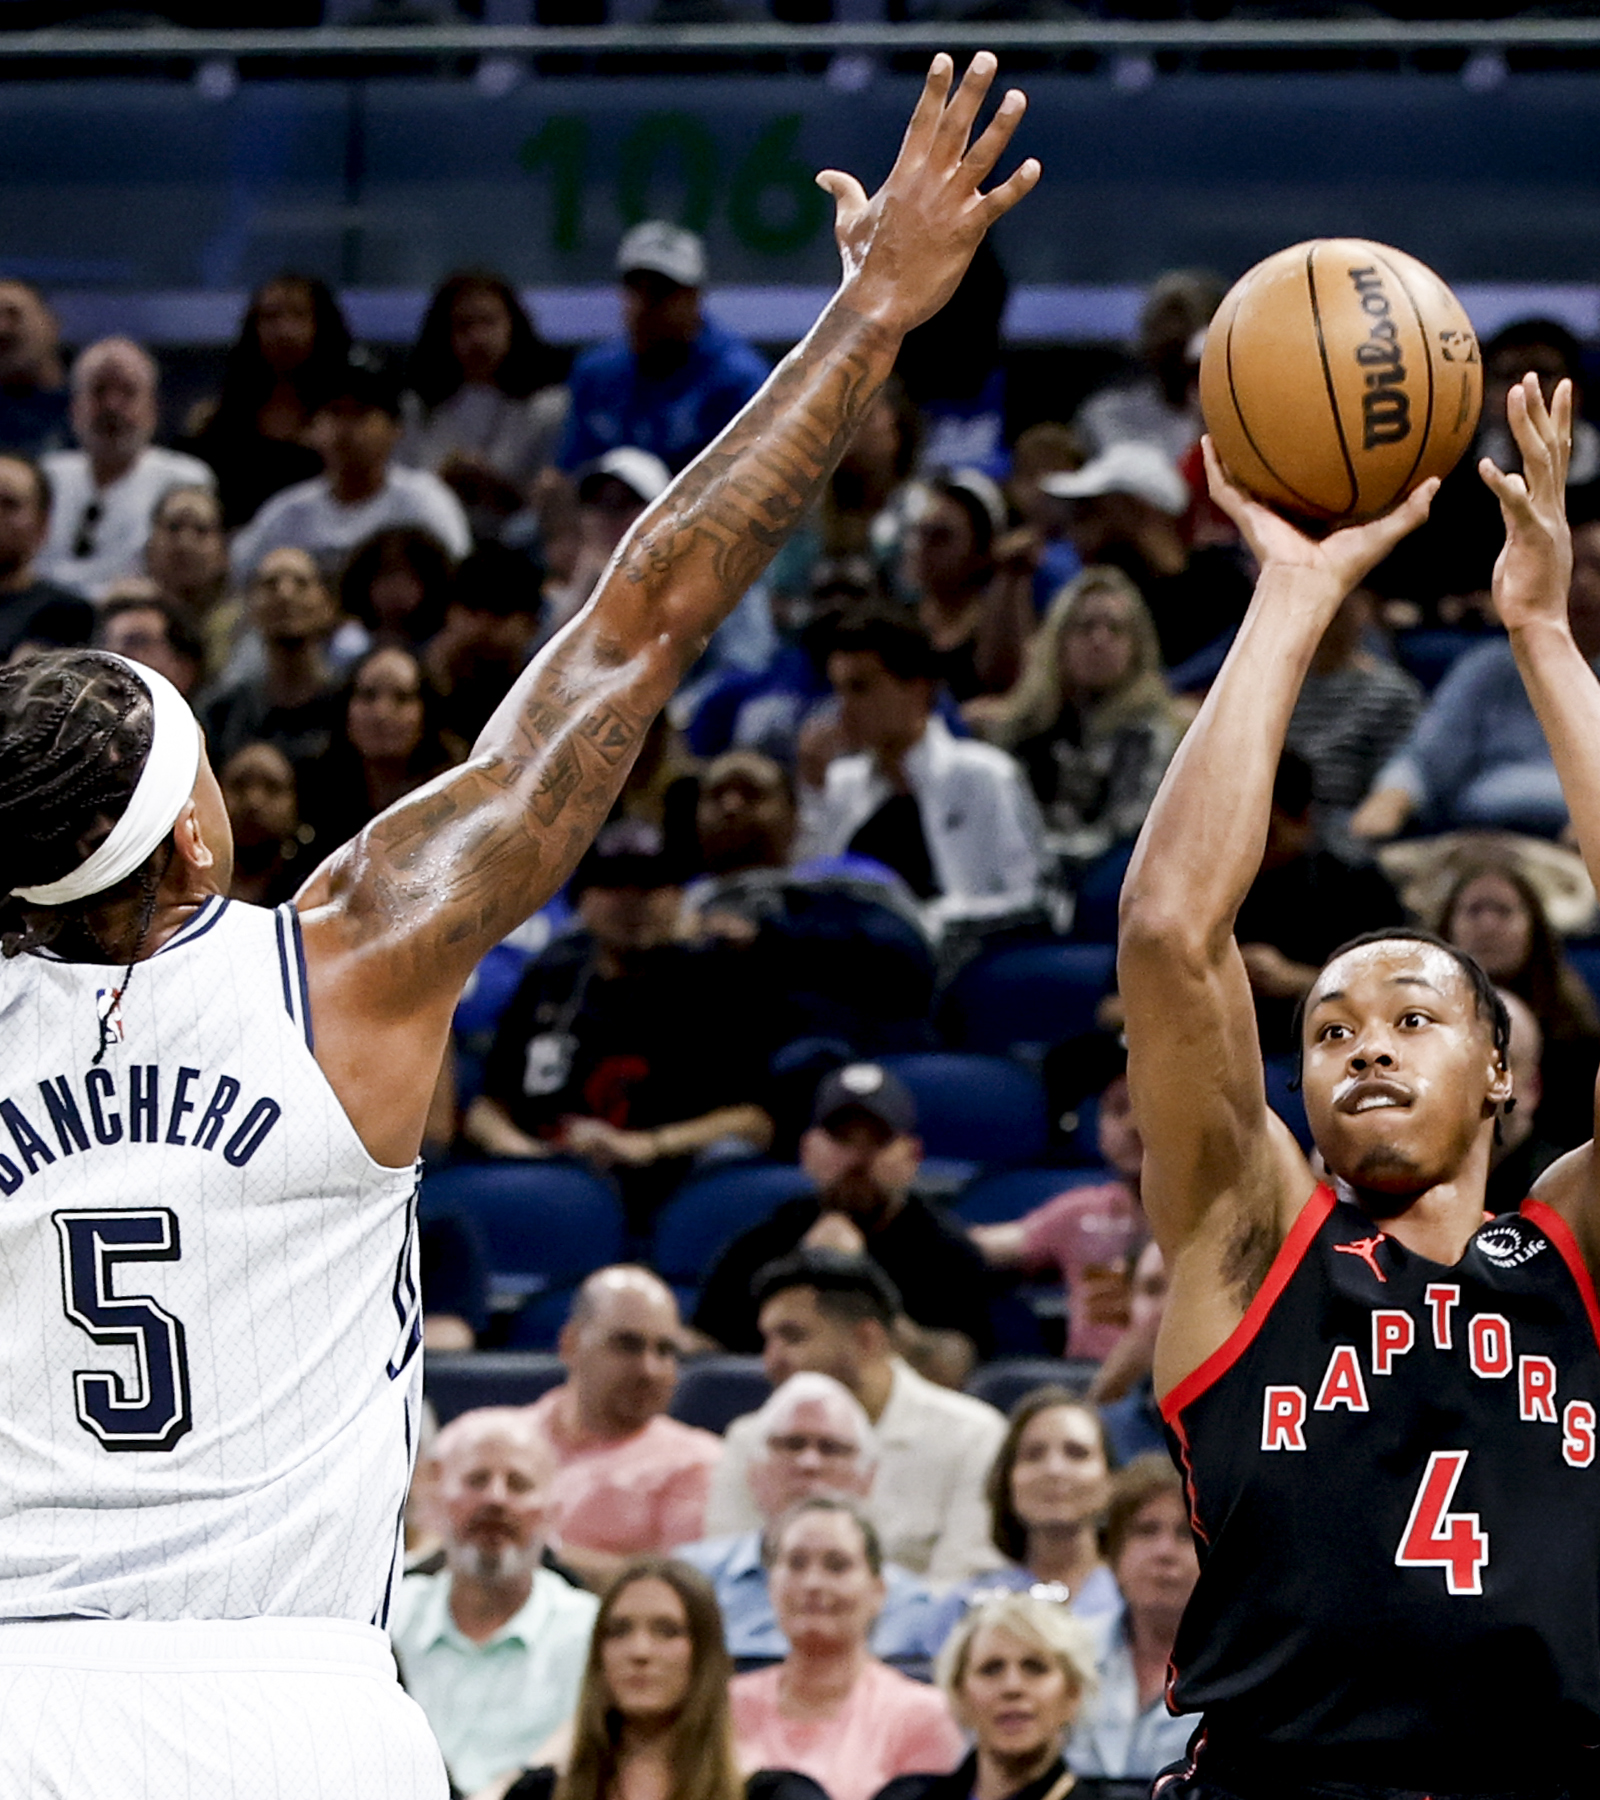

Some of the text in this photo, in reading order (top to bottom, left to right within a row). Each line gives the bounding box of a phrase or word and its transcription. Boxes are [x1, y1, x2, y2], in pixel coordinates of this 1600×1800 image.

[515, 108, 833, 257] 106
[1348, 265, 1412, 451] Wilson
[51, 1207, 194, 1453] 5
[1260, 1282, 1597, 1469] RAPTORS
[1394, 1449, 1489, 1596] 4
